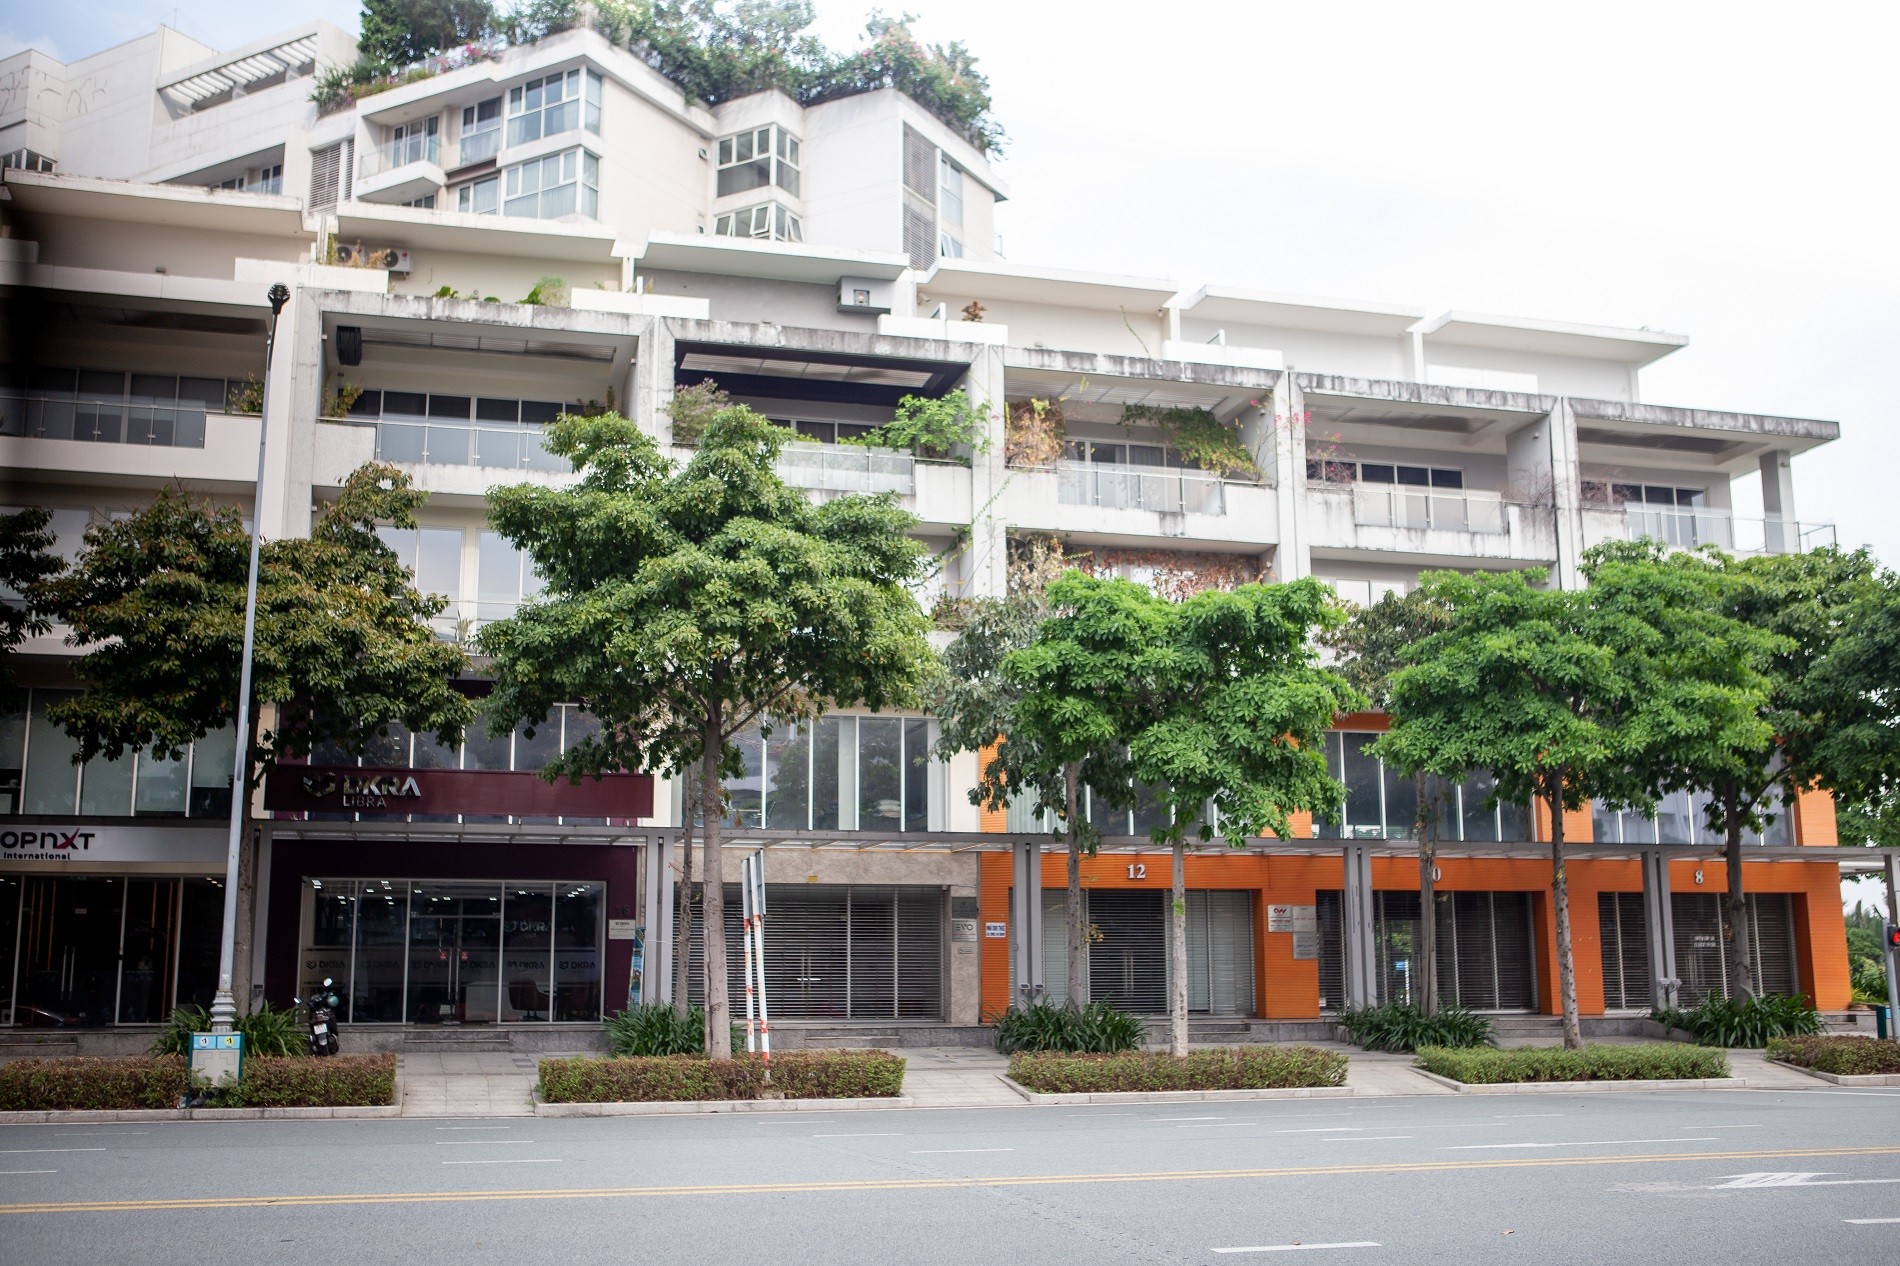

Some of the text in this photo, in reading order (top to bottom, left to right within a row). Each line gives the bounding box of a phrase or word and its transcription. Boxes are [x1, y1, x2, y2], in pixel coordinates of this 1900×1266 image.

[343, 775, 422, 797] DKRA
[343, 795, 387, 808] LIBRA
[3, 852, 71, 861] International
[1127, 864, 1147, 880] 12
[1695, 870, 1704, 884] 8
[319, 960, 345, 969] DKRA
[571, 960, 596, 969] DKRA
